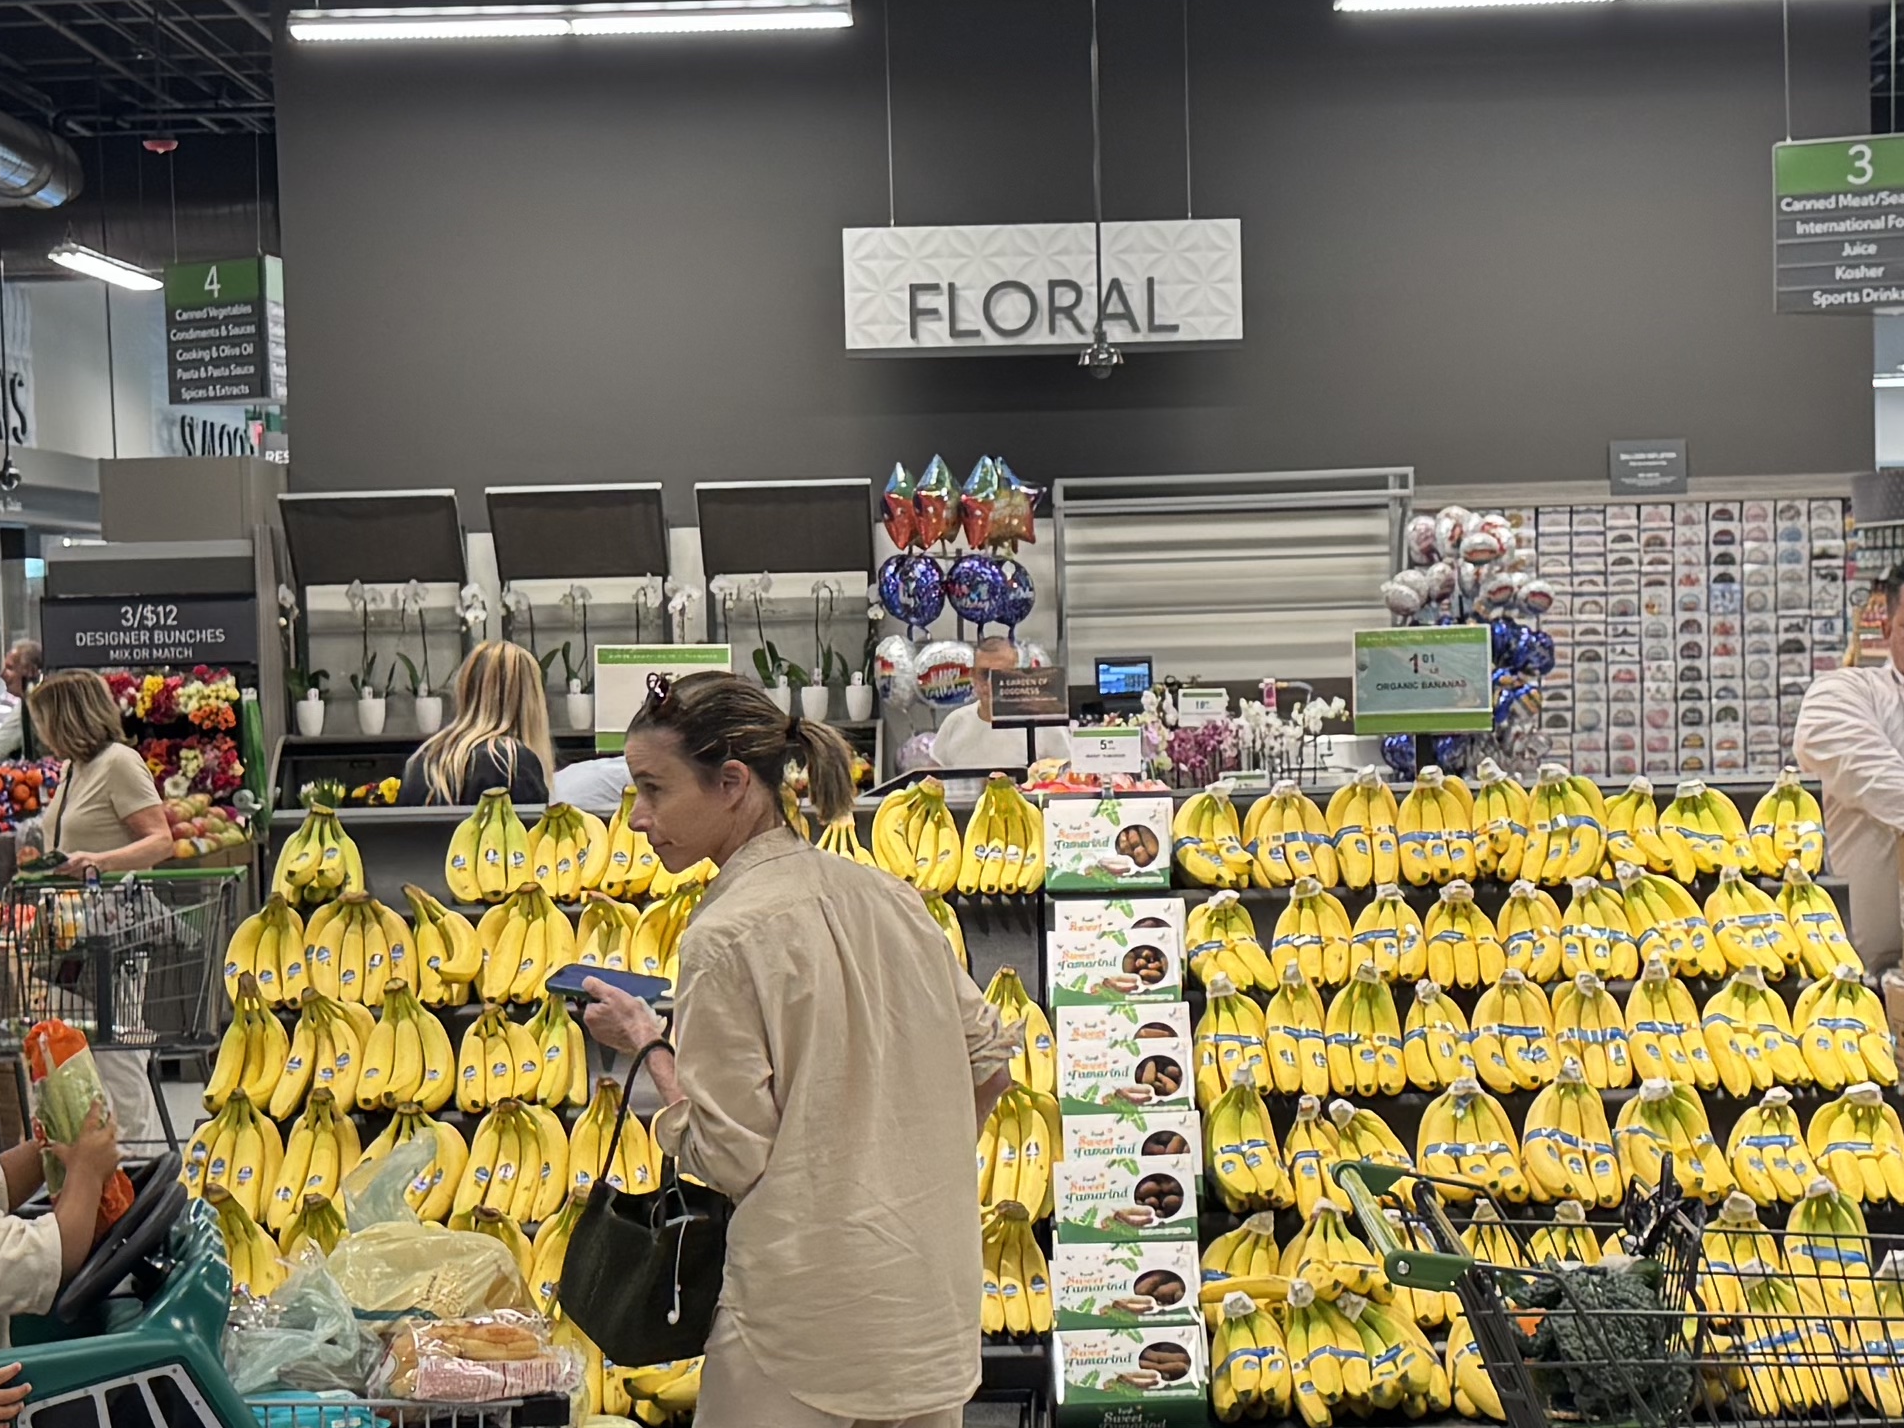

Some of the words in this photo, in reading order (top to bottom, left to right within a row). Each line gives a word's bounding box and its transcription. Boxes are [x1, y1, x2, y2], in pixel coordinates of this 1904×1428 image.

[1847, 144, 1874, 184] 3
[1781, 194, 1836, 212] Canned
[1796, 217, 1886, 235] International
[1842, 242, 1877, 257] Juice
[1835, 265, 1885, 280] Kosher
[204, 264, 222, 299] 4
[1813, 289, 1860, 308] Sports
[176, 307, 208, 322] Canned
[208, 304, 252, 320] Vegetables
[908, 276, 1180, 340] FLORAL
[170, 326, 220, 341] Condiments
[221, 325, 228, 337] &
[228, 323, 256, 337] Sauces
[176, 348, 210, 362] Cooking
[211, 347, 219, 358] &
[219, 345, 241, 358] Olive
[241, 343, 254, 356] Oil
[177, 367, 198, 381] Pasta
[199, 366, 207, 379] &
[208, 366, 229, 379] Pasta
[230, 363, 255, 376] Sauce
[181, 386, 207, 401] Spices
[208, 385, 214, 398] &
[215, 383, 250, 396] Extracts
[121, 604, 178, 628] 3/$12
[76, 631, 150, 647] DESIGNER
[154, 628, 226, 645] BUNCHES
[110, 649, 131, 661] MIX
[133, 648, 150, 660] OR
[153, 647, 193, 660] MATCH
[1409, 653, 1419, 674] 1
[1422, 654, 1435, 663] 01
[1006, 678, 1037, 686] GARDEN
[1038, 677, 1049, 685] OF
[1376, 681, 1419, 691] ORGANIC
[1421, 679, 1467, 690] BANANAS
[1054, 836, 1110, 850] Tamarind
[1057, 956, 1117, 970] Tamarind
[1072, 1059, 1108, 1070] Sweet
[1068, 1065, 1129, 1081] Tamarind
[1078, 1135, 1114, 1146] Sweet
[1065, 1188, 1128, 1204] Tamarind
[1061, 1279, 1129, 1294] Tamarind
[1066, 1275, 1105, 1285] Sweet
[1065, 1353, 1132, 1367] Tamarind
[1069, 1347, 1108, 1358] Sweet
[1103, 1411, 1144, 1424] Sweet
